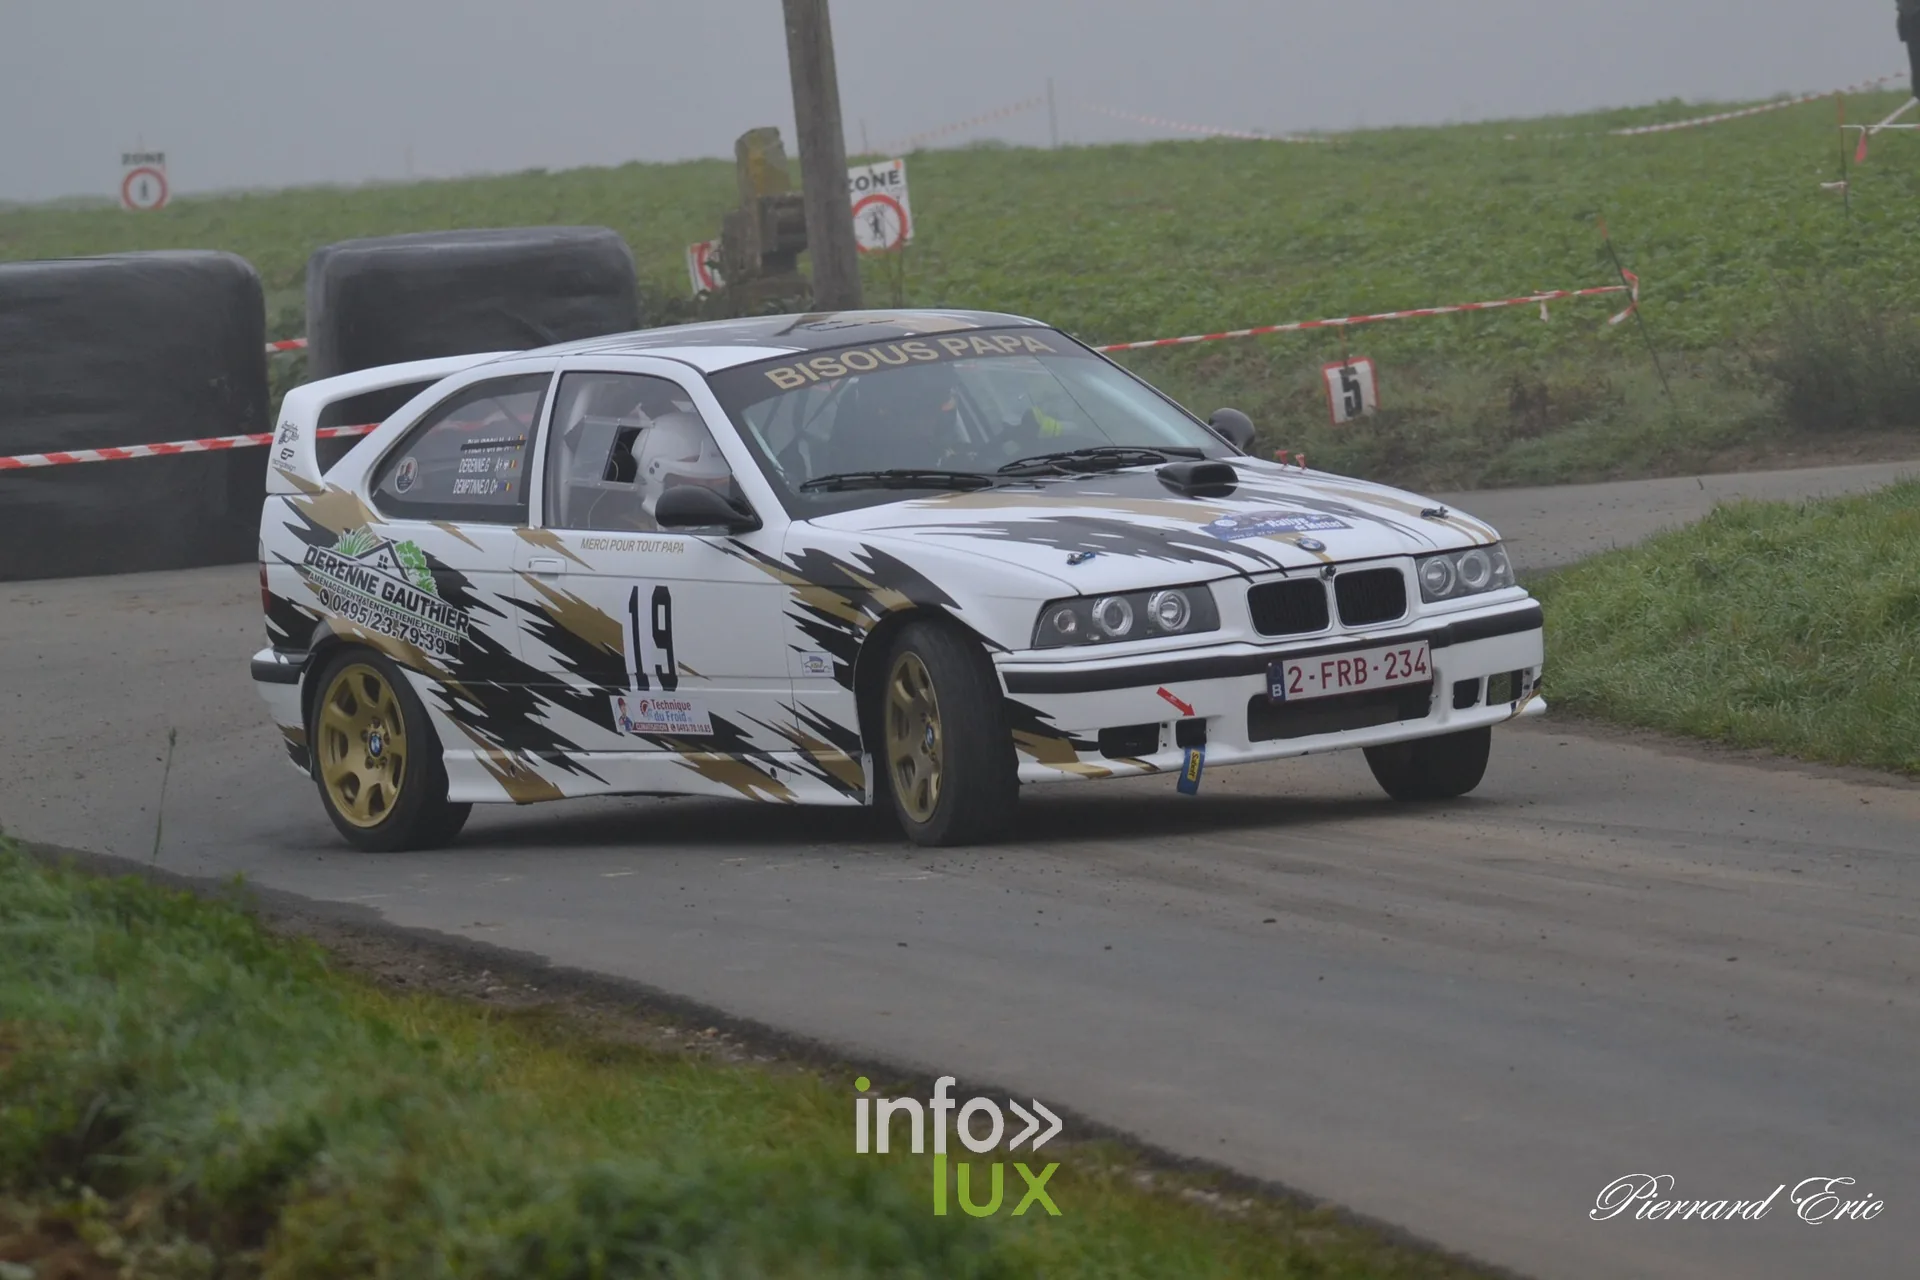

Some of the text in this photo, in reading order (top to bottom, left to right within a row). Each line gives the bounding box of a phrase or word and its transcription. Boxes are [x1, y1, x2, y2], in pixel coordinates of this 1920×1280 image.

[764, 335, 1057, 389] BISOUS PAPA
[1339, 366, 1363, 417] 5
[580, 538, 685, 554] MERCI POUR TOUT PAPA
[303, 546, 470, 633] DERENNE GAUTHIER
[331, 594, 447, 656] 0495/23.79.39
[368, 601, 414, 626] ENTRETIEN
[628, 585, 679, 692] 19
[1271, 683, 1283, 697] B
[1287, 647, 1427, 694] 2-FRB-234
[650, 699, 692, 713] Technique
[653, 710, 665, 722] du
[665, 710, 687, 722] Froid
